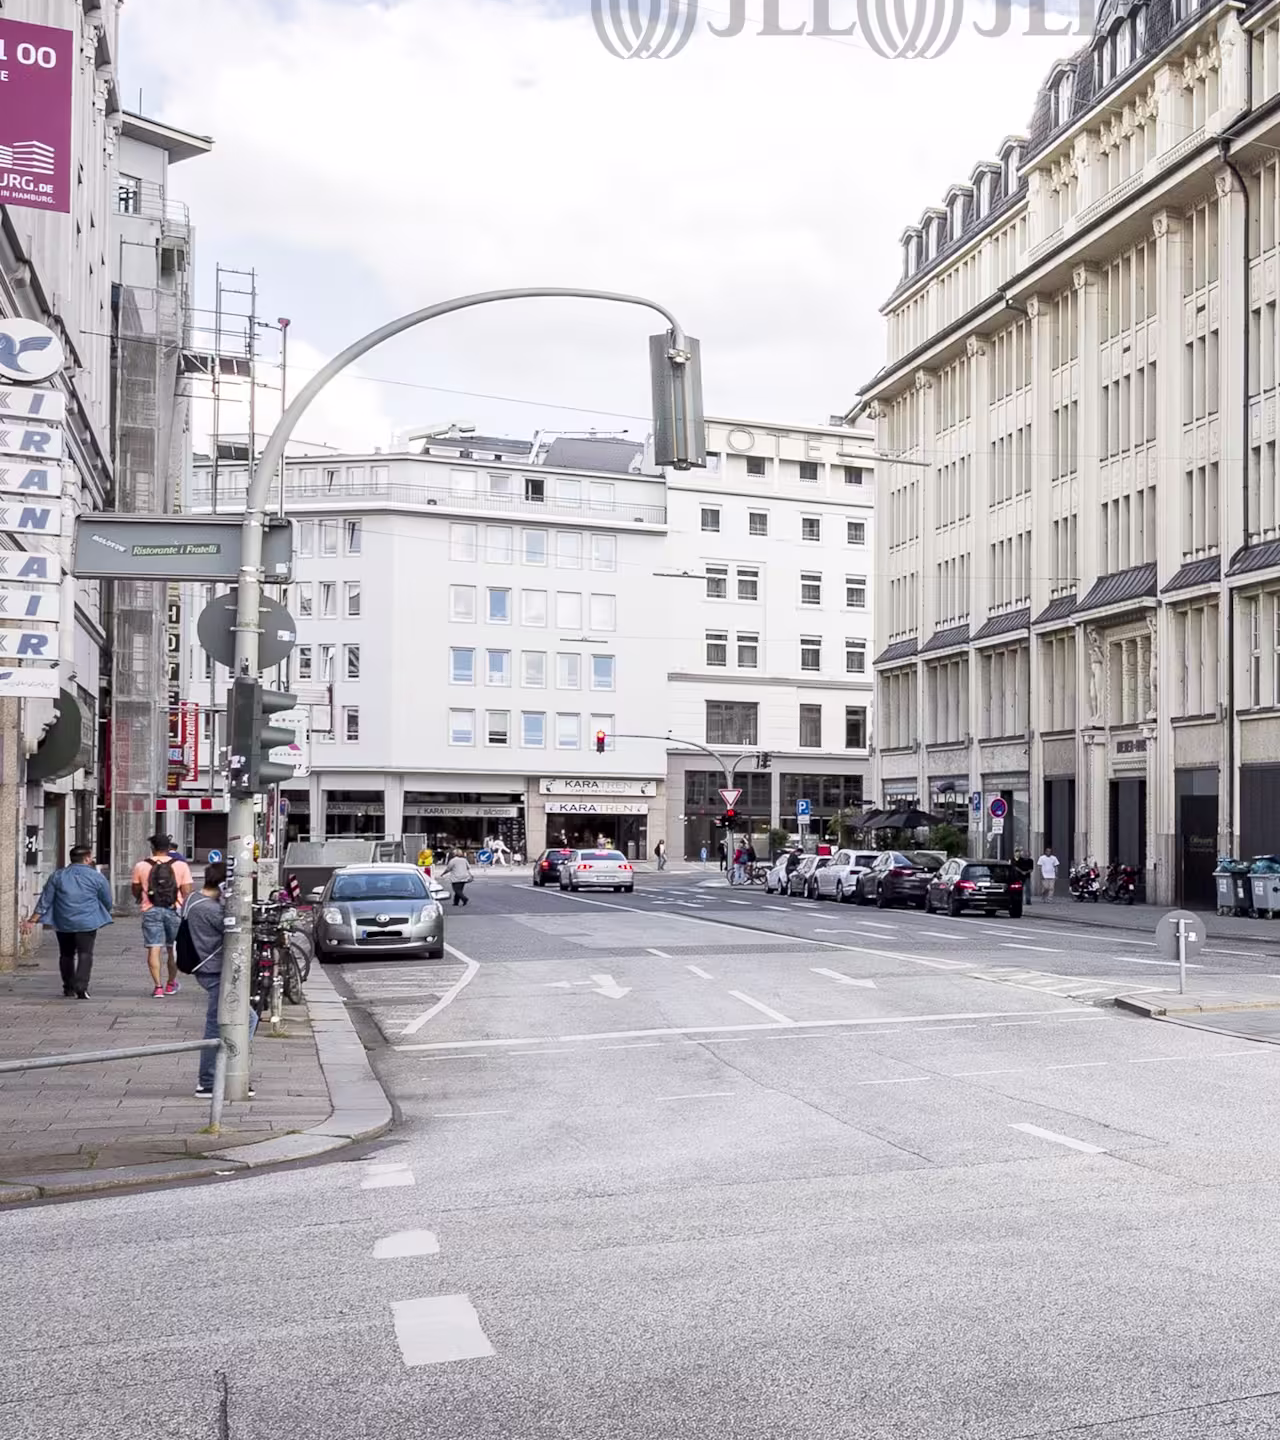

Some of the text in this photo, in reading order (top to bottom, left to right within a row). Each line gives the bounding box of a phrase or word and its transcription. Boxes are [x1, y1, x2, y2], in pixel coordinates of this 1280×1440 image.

[132, 545, 178, 556] Ristorante
[186, 544, 218, 554] Fratelli
[564, 780, 632, 789] KARATREN
[560, 804, 633, 813] KARATREN
[799, 801, 807, 815] P
